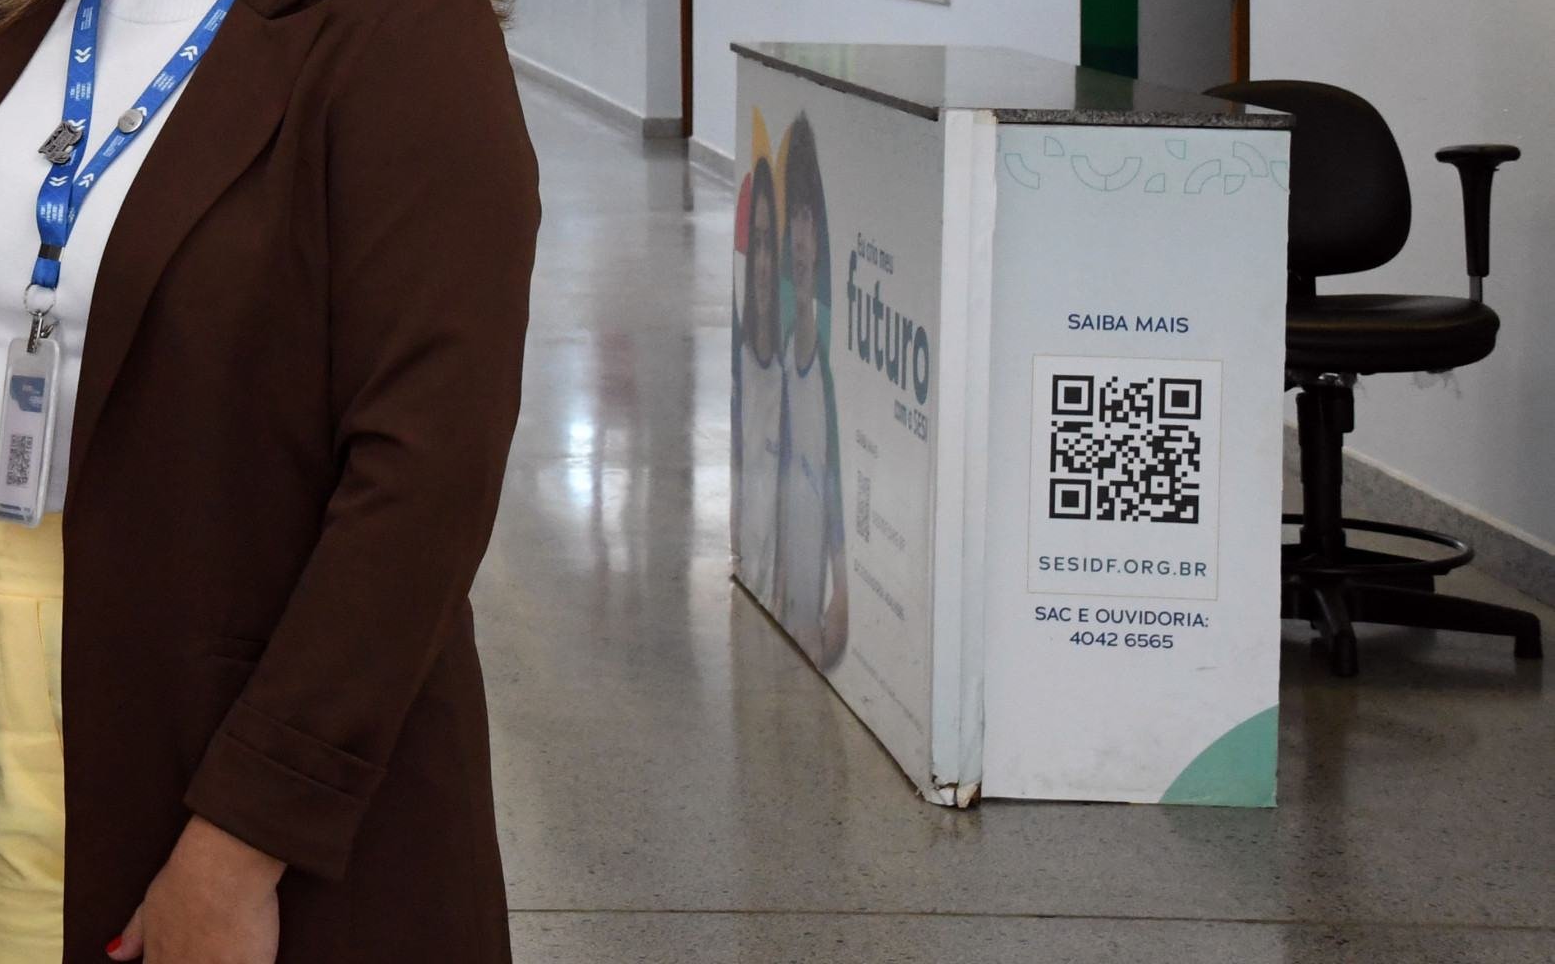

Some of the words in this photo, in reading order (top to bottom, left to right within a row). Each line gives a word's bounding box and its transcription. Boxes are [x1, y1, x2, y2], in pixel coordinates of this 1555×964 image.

[847, 249, 930, 406] futuro
[1067, 313, 1129, 332] SAIBA
[1135, 315, 1190, 334] MAIS
[914, 409, 928, 443] SESI
[1038, 555, 1208, 577] SESIDF.ORG.BR
[1034, 606, 1072, 622] SAC
[1078, 607, 1090, 623] E
[1095, 608, 1210, 628] OUVIDORIA:
[1069, 631, 1118, 647] 4042
[1124, 632, 1174, 649] 6565
